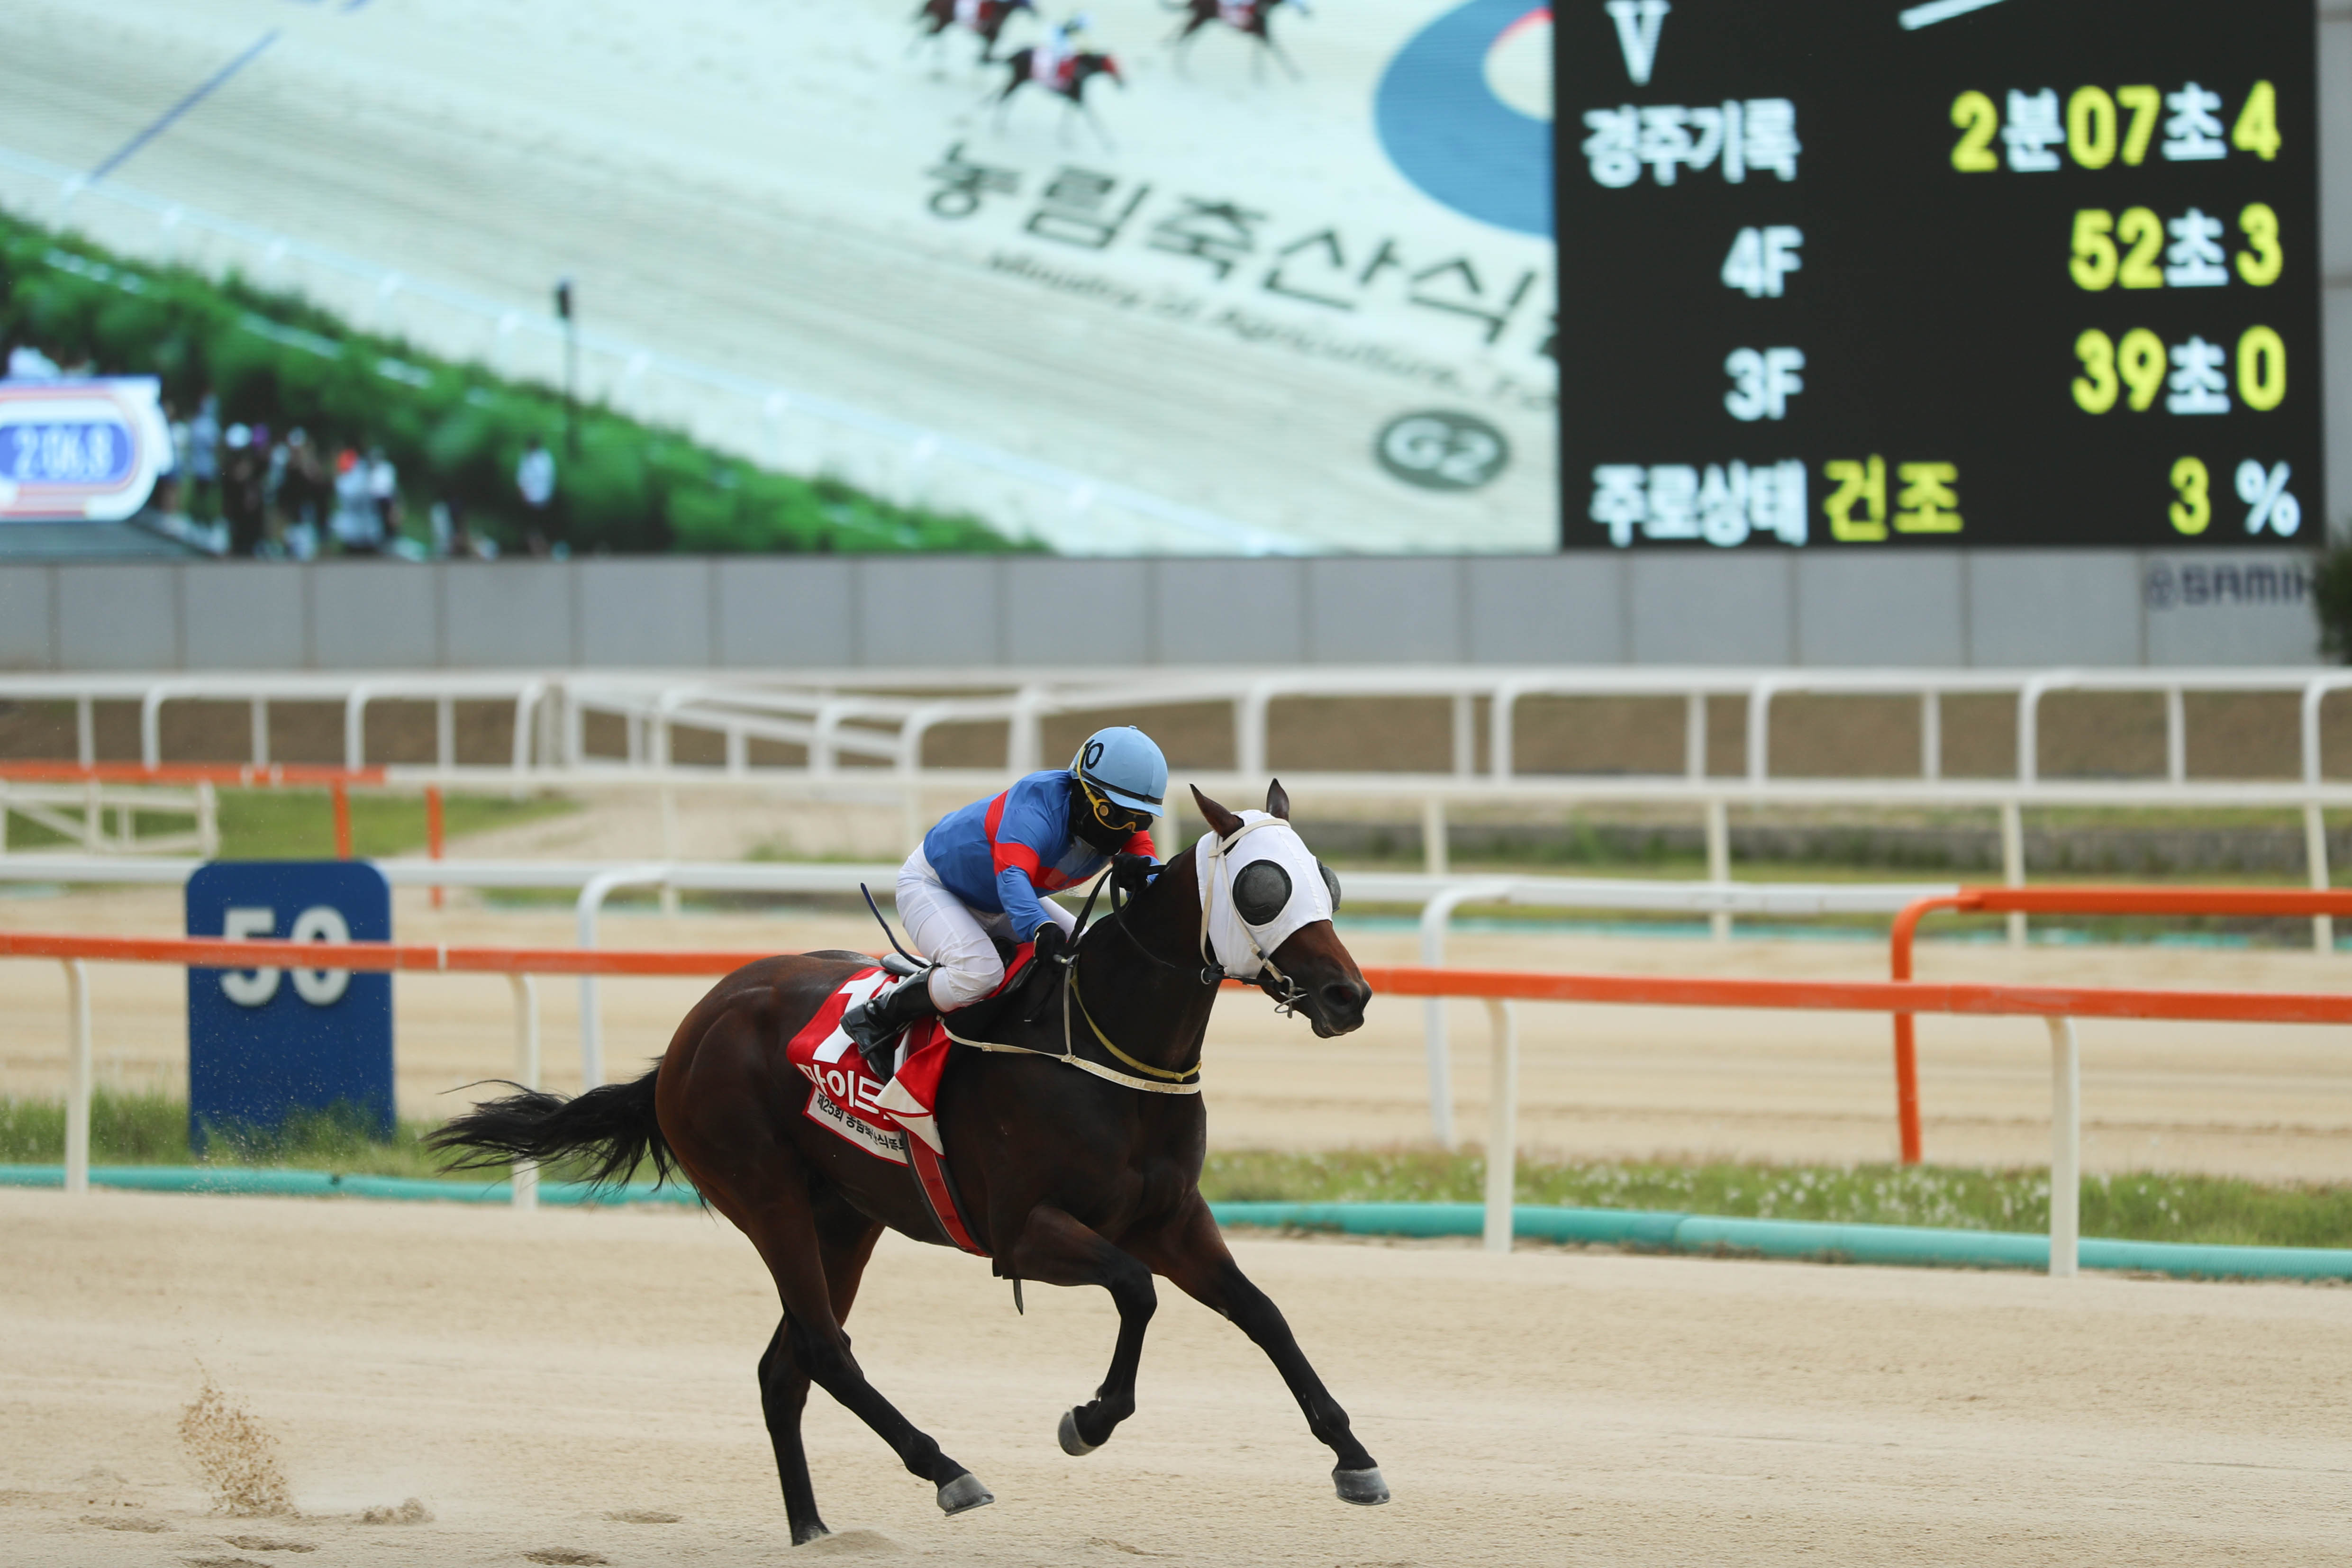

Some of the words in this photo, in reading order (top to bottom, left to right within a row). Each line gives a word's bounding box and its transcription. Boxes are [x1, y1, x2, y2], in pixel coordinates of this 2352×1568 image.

[1581, 97, 1802, 189] 경주기록
[923, 141, 1558, 358] 농림축산식
[1720, 225, 1804, 298] 4F
[1724, 346, 1806, 422] 3F
[1589, 459, 1809, 548] 주로상태
[2168, 456, 2212, 535] 3
[2234, 459, 2302, 537] %
[1078, 739, 1104, 770] 10
[219, 905, 352, 1007] 50
[796, 1062, 895, 1120] 마이드
